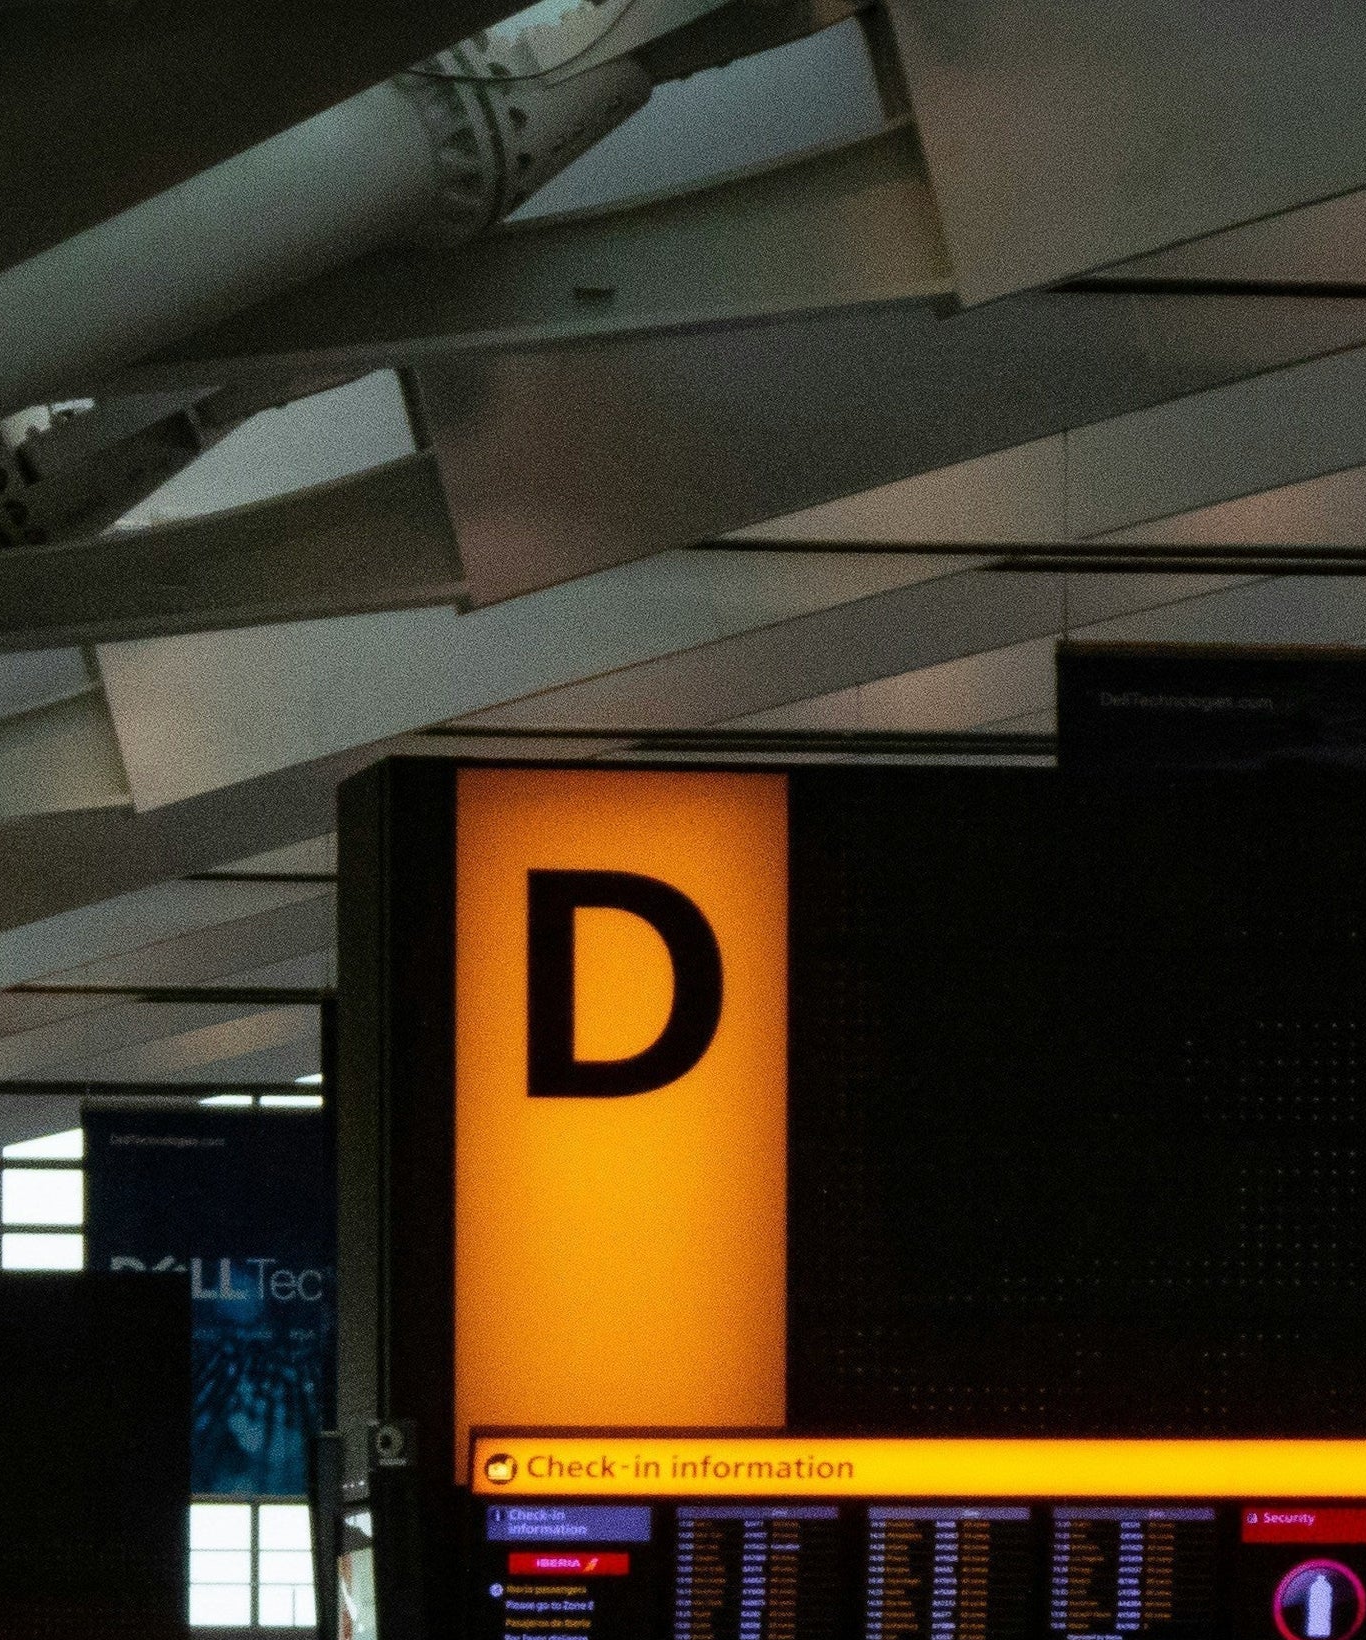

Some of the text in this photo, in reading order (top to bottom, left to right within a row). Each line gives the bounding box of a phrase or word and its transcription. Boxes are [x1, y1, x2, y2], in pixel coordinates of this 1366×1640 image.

[528, 868, 724, 1098] D
[527, 1454, 854, 1480] Check-in information
[1263, 1512, 1316, 1526] Security
